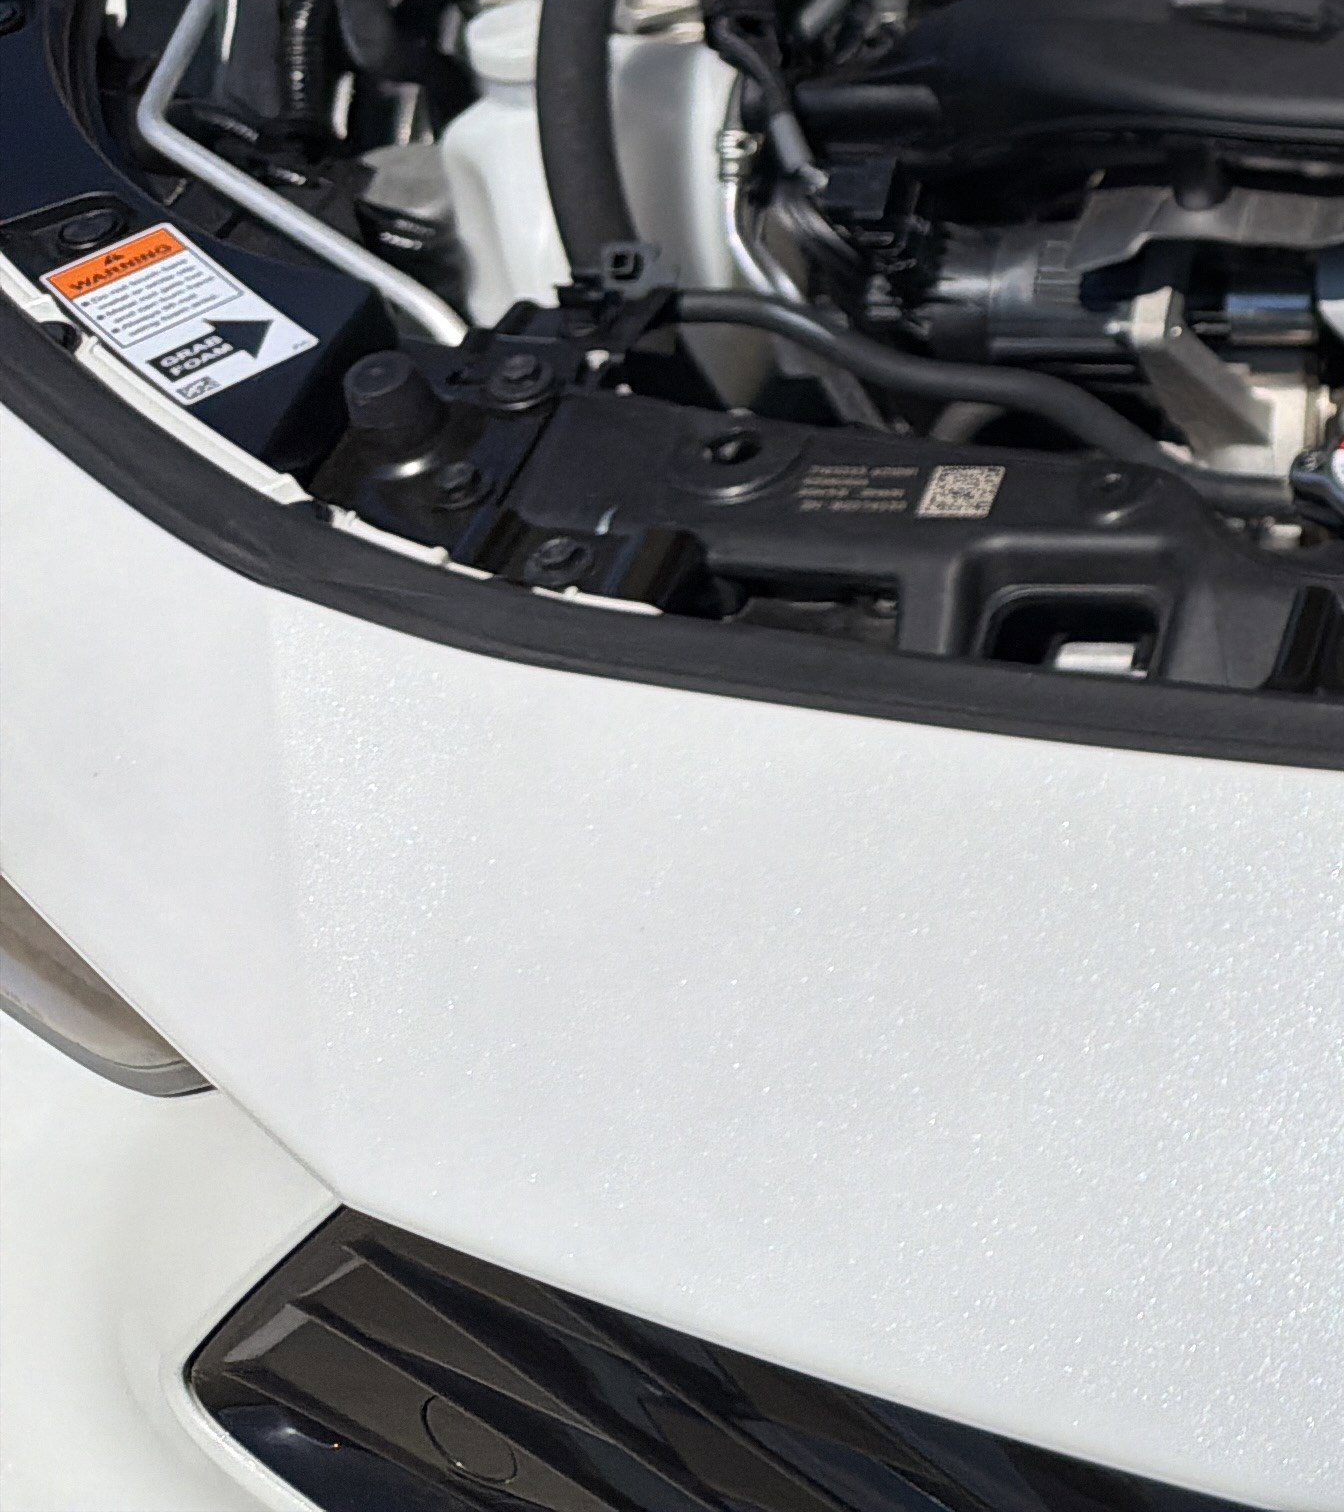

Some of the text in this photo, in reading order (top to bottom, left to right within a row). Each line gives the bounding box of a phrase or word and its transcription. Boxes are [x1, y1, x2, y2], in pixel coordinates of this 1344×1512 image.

[69, 244, 172, 290] WARNING
[160, 335, 223, 367] GRAB
[169, 343, 233, 376] FOAM
